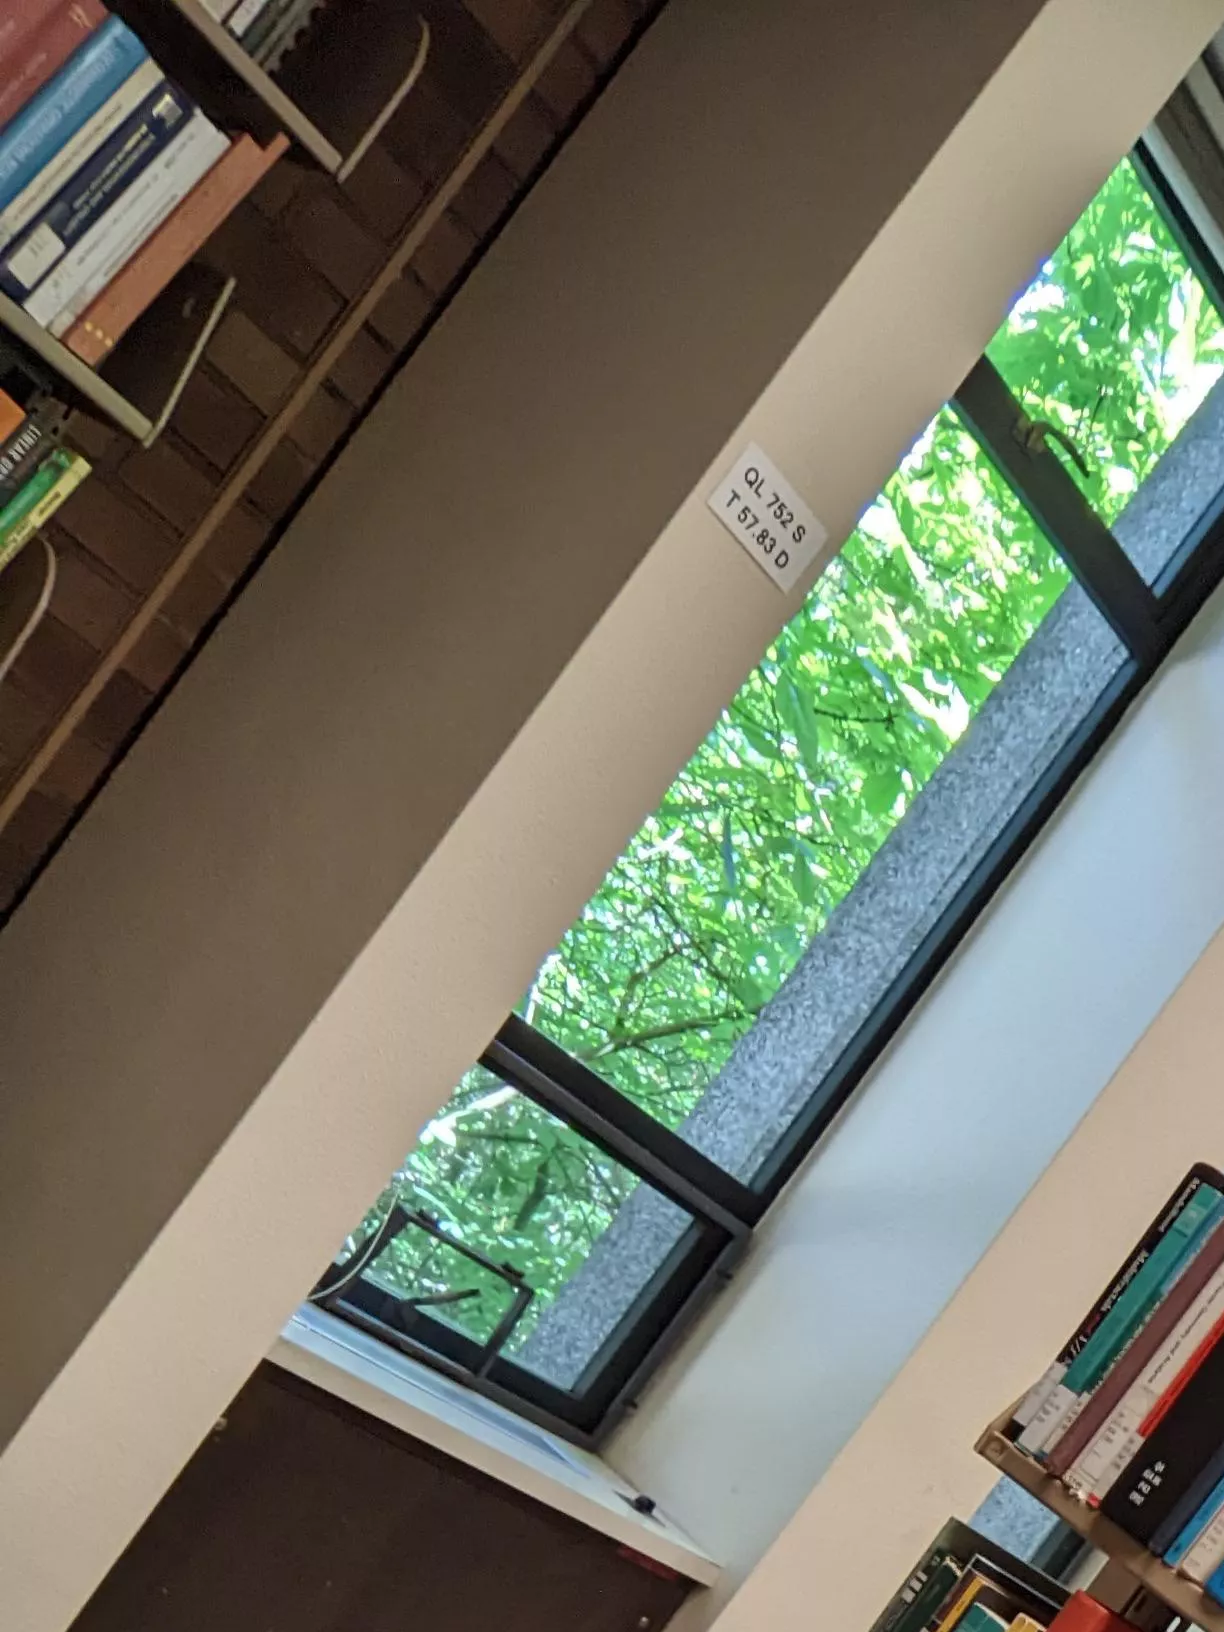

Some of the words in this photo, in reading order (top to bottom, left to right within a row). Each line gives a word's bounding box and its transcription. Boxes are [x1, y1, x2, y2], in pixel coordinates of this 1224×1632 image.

[726, 489, 741, 508] T
[737, 505, 776, 554] 57.83
[774, 549, 789, 568] D
[745, 467, 765, 498] QL
[766, 492, 794, 529] 752
[792, 525, 806, 543] S
